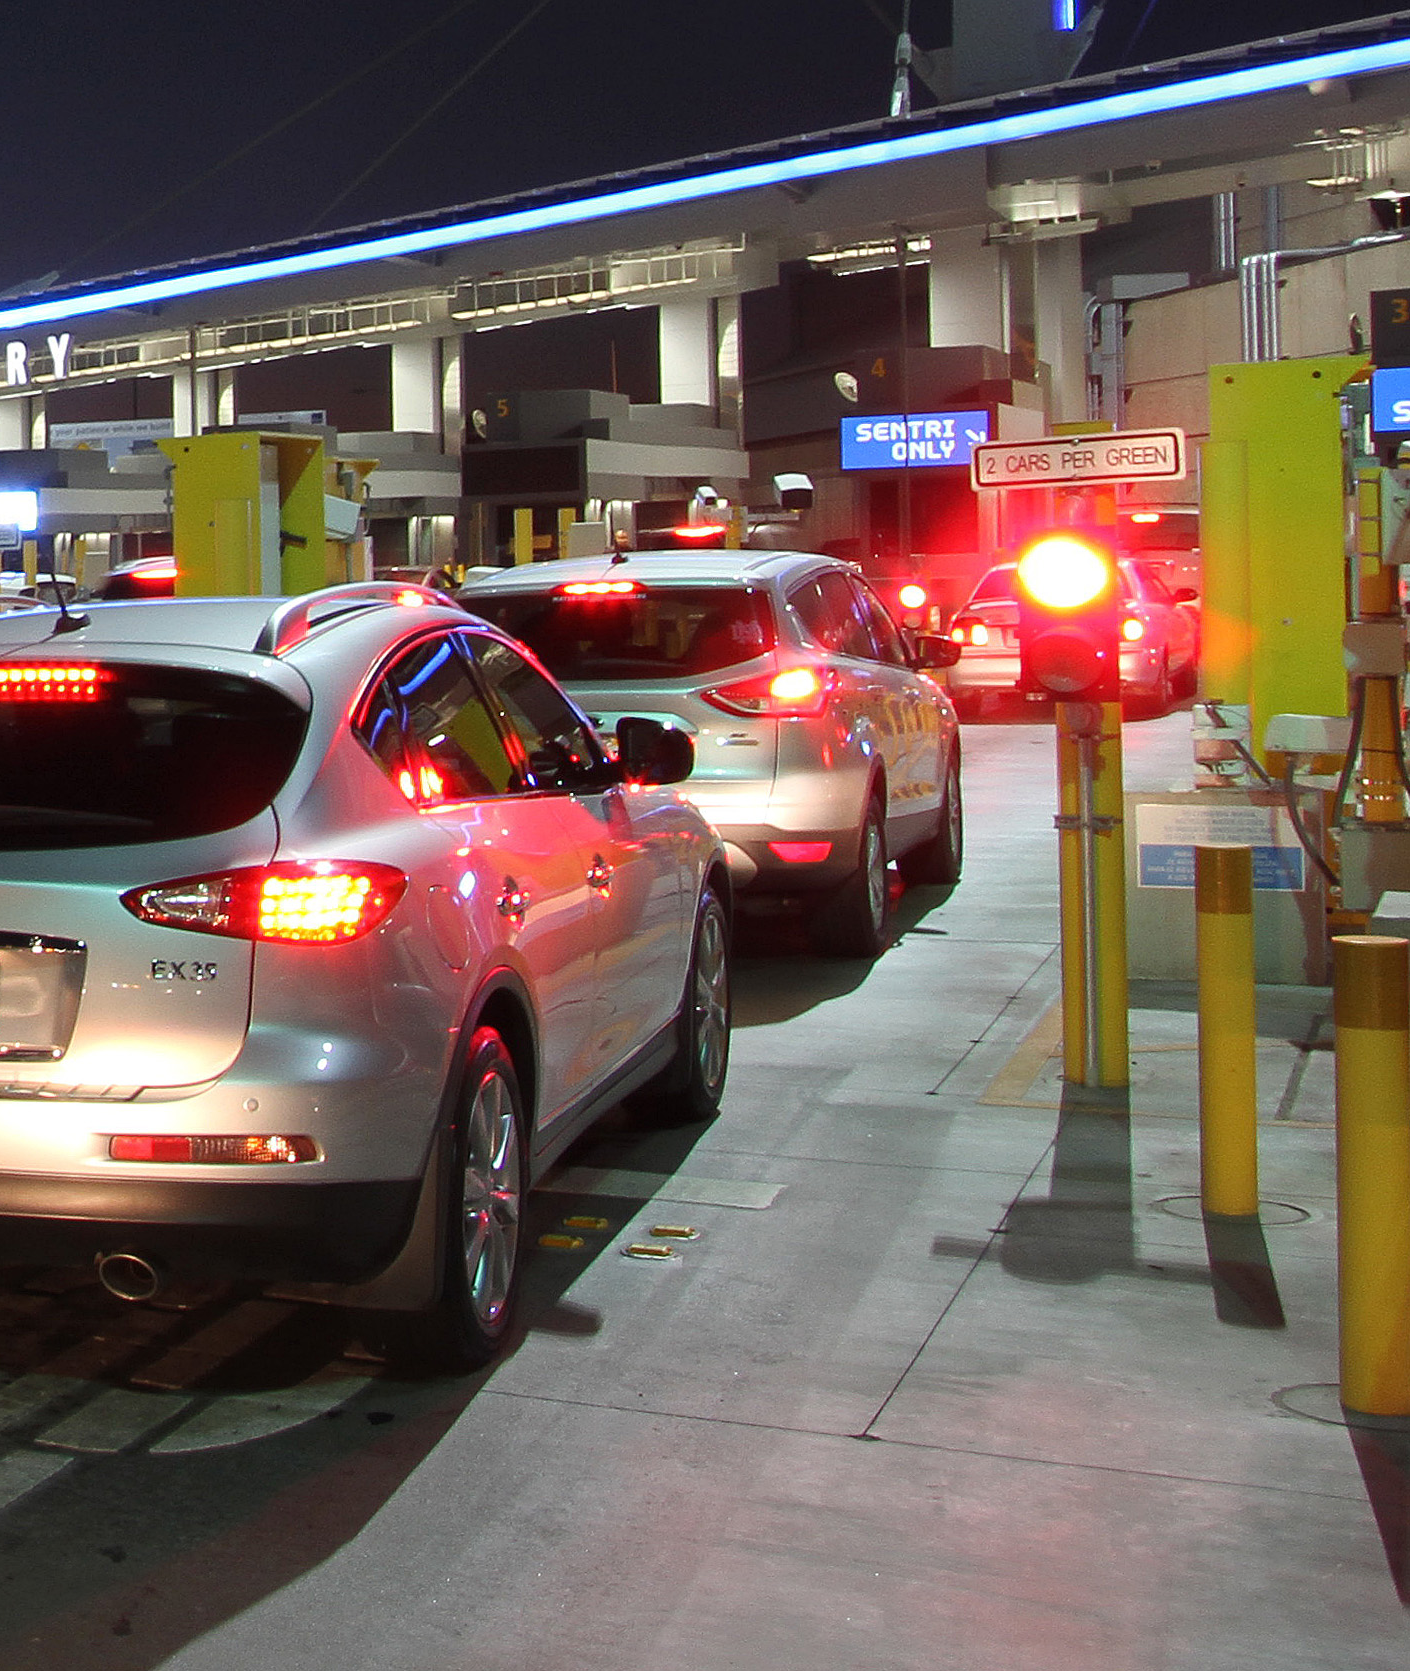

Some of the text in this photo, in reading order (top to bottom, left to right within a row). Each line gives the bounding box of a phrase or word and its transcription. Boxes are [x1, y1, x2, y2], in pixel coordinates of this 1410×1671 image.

[870, 357, 887, 378] 4
[497, 398, 509, 418] 5
[855, 418, 955, 443] SENTRI
[891, 440, 955, 461] ONLY
[985, 445, 1168, 475] 2 CARS PER GREEN
[151, 958, 219, 982] EX35
